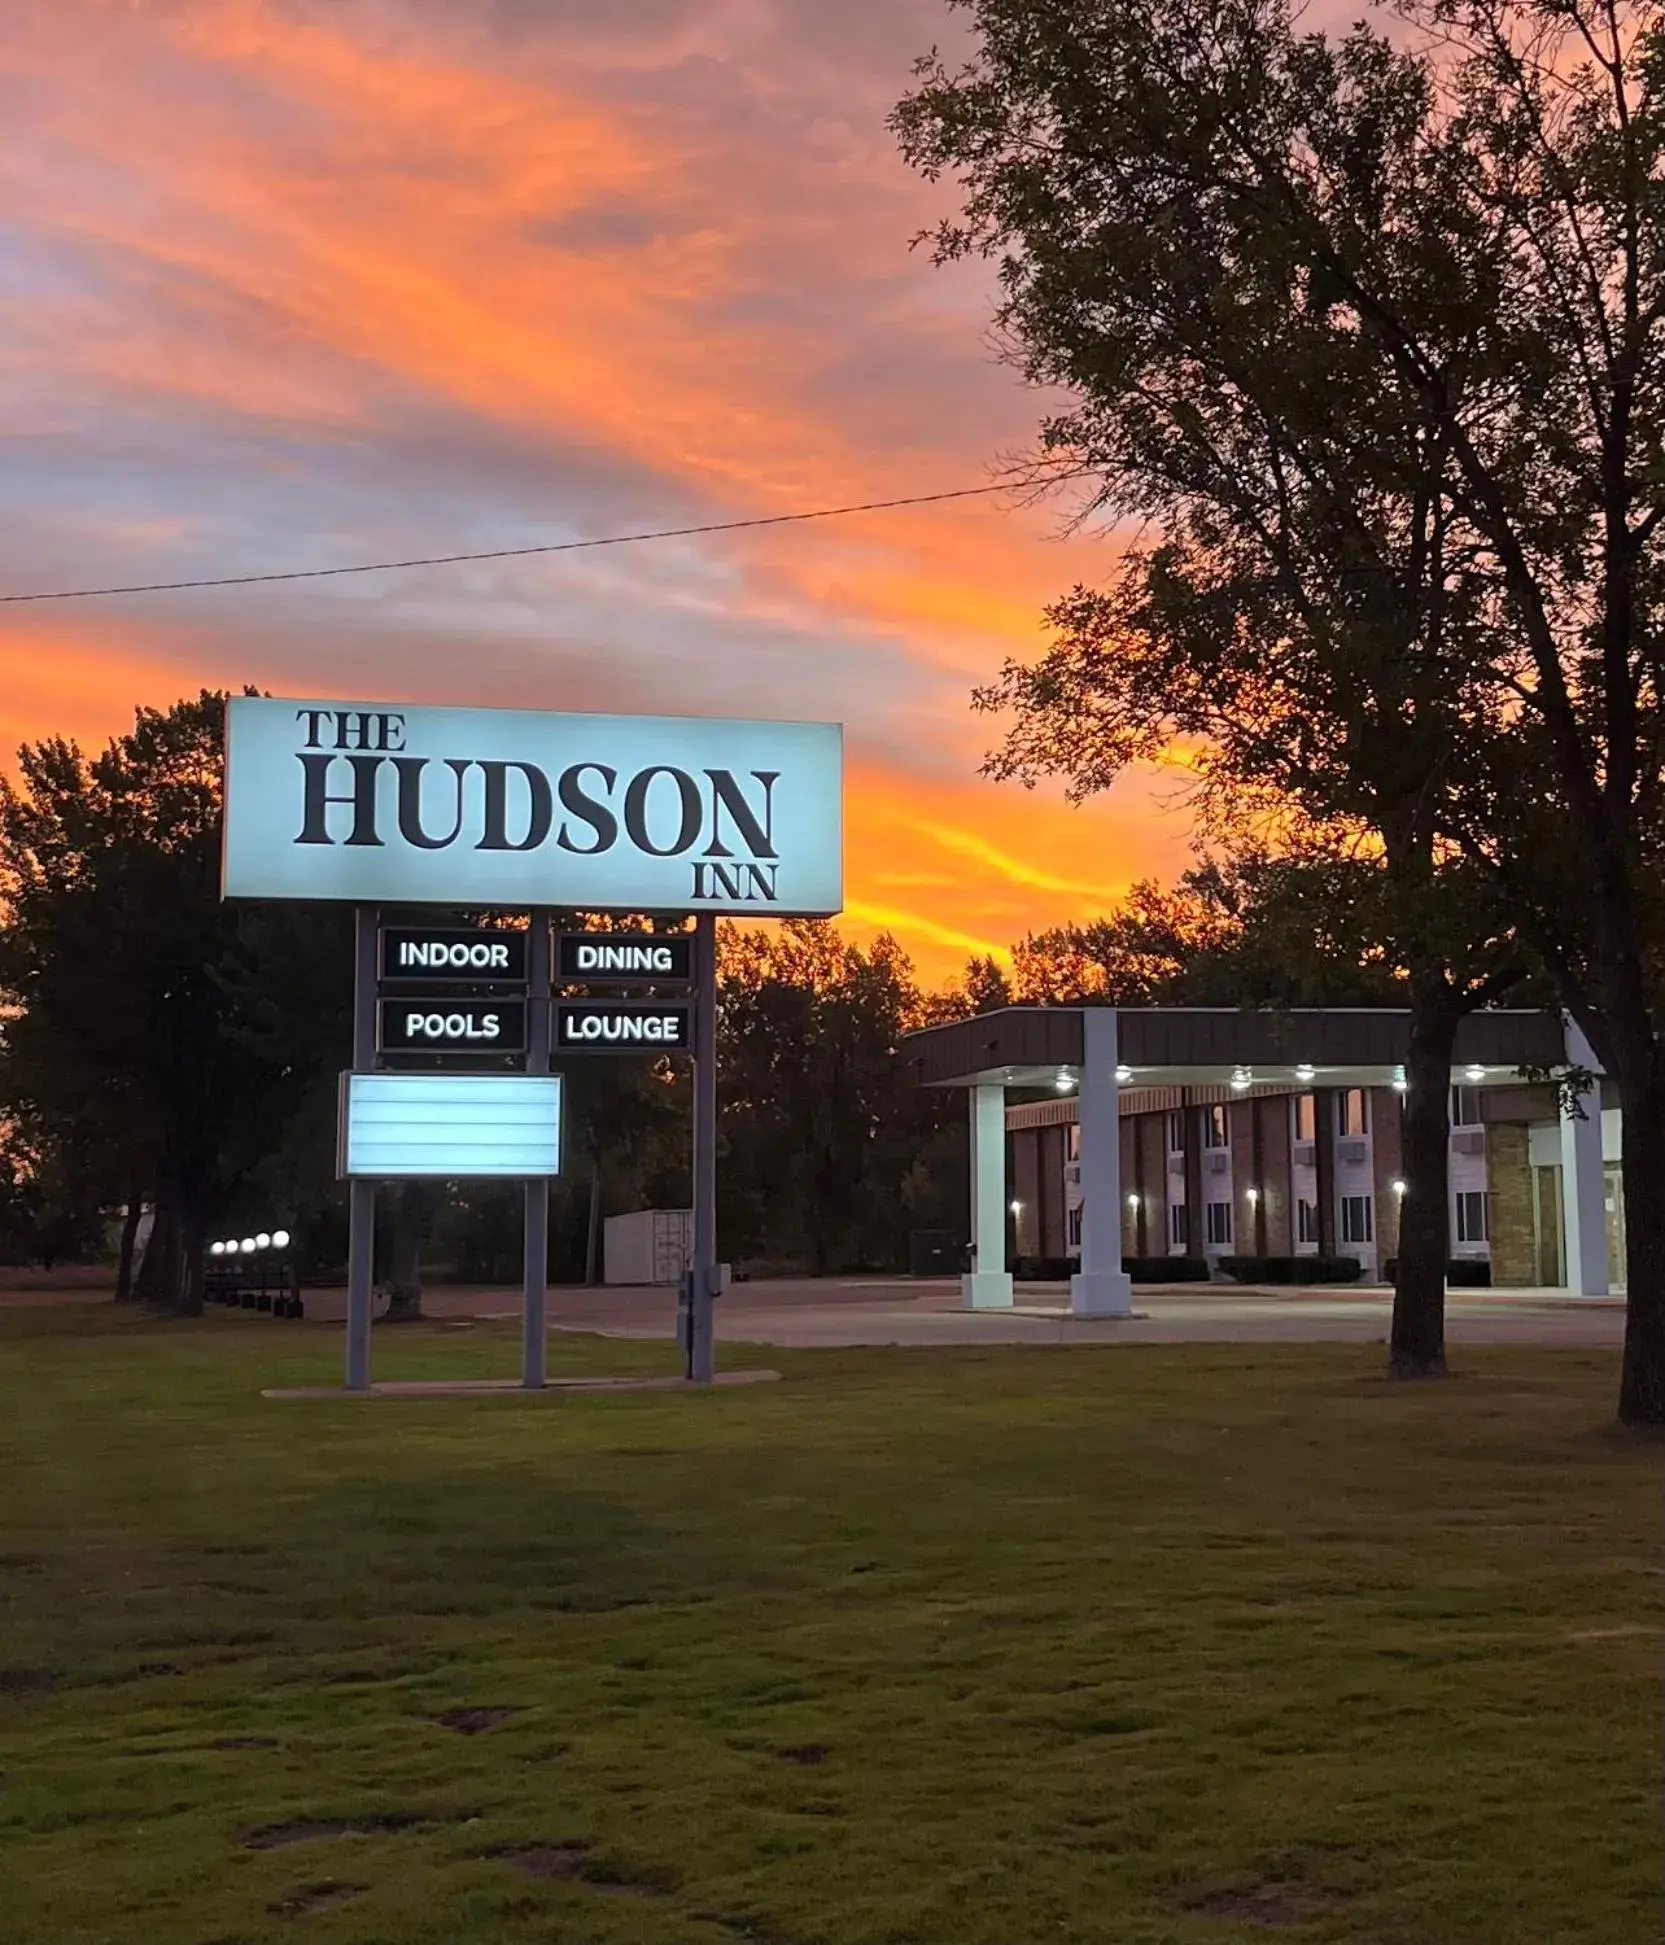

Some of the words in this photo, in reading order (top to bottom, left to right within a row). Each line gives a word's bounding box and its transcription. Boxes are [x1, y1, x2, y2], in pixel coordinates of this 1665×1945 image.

[296, 710, 405, 751] THE
[293, 753, 781, 858] HUDSON
[690, 861, 779, 901] INN
[399, 943, 509, 969] INDOOR
[577, 945, 673, 971] DINING
[405, 1013, 500, 1039] POOLS
[566, 1015, 679, 1041] LOUNGE
